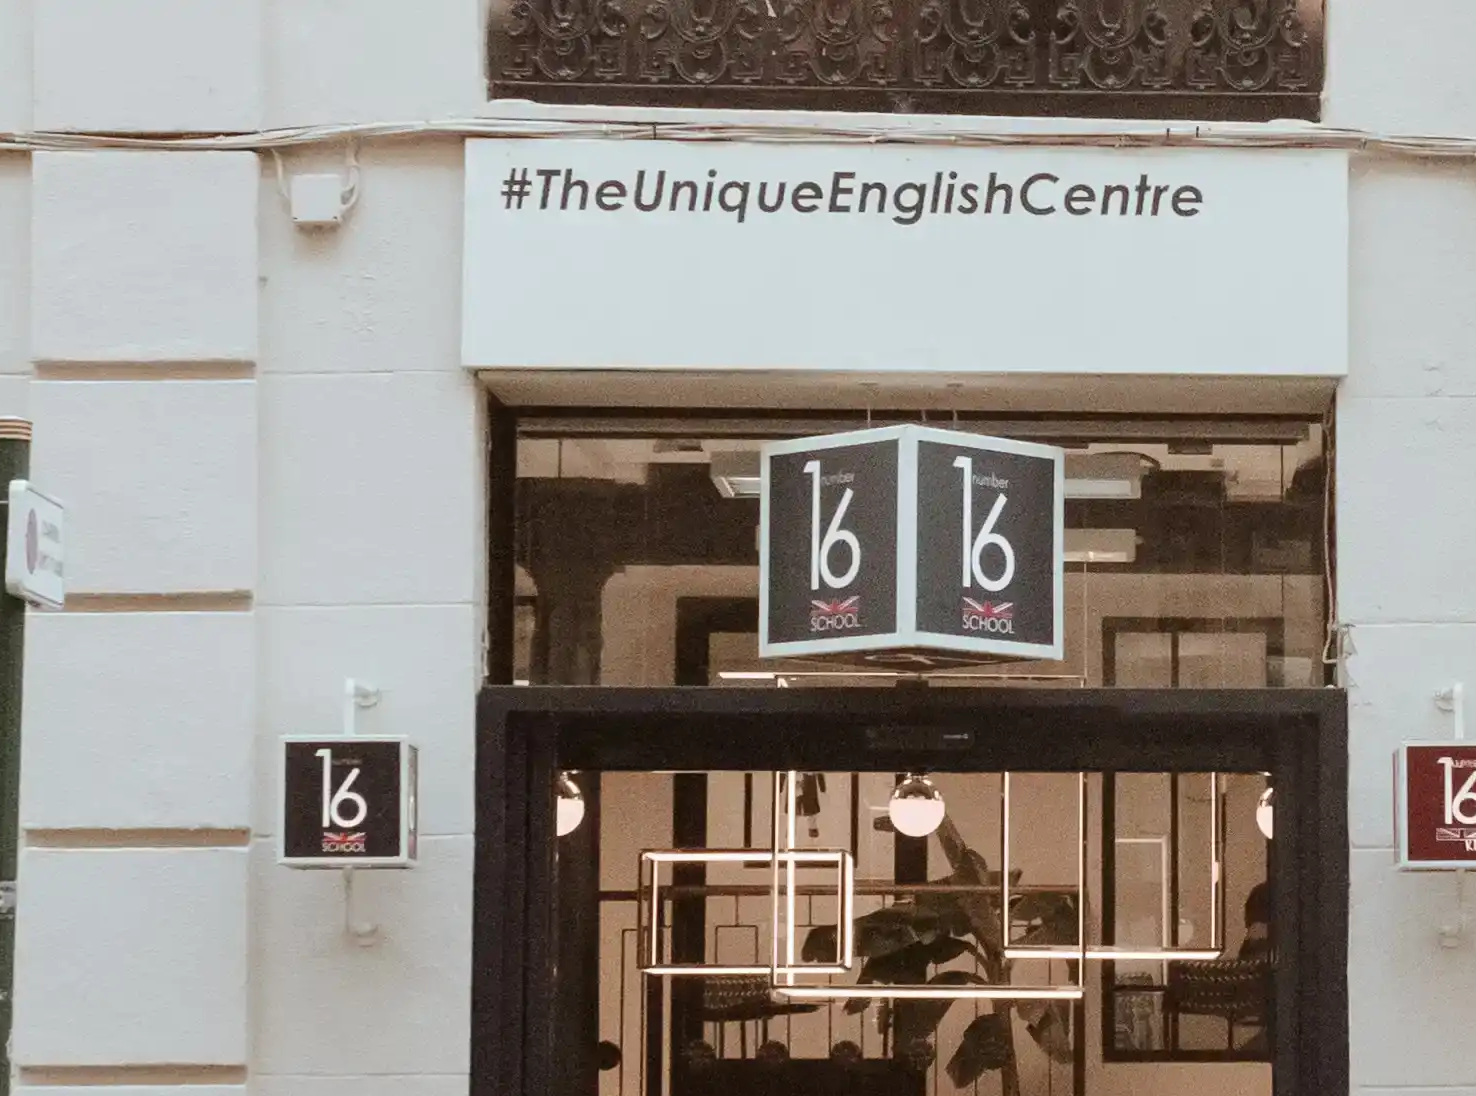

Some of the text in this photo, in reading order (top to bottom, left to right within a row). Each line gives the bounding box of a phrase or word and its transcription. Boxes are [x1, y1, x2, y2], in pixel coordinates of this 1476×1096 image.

[500, 168, 1204, 225] #TheUniqueEnglishCentre
[821, 472, 855, 487] number
[972, 472, 1010, 489] number
[803, 460, 861, 590] 16
[952, 456, 1015, 592] 16
[810, 613, 862, 632] SCHOOL
[962, 615, 1015, 634] SCHOOL
[314, 748, 368, 828] 16
[322, 842, 367, 853] SCHOOL
